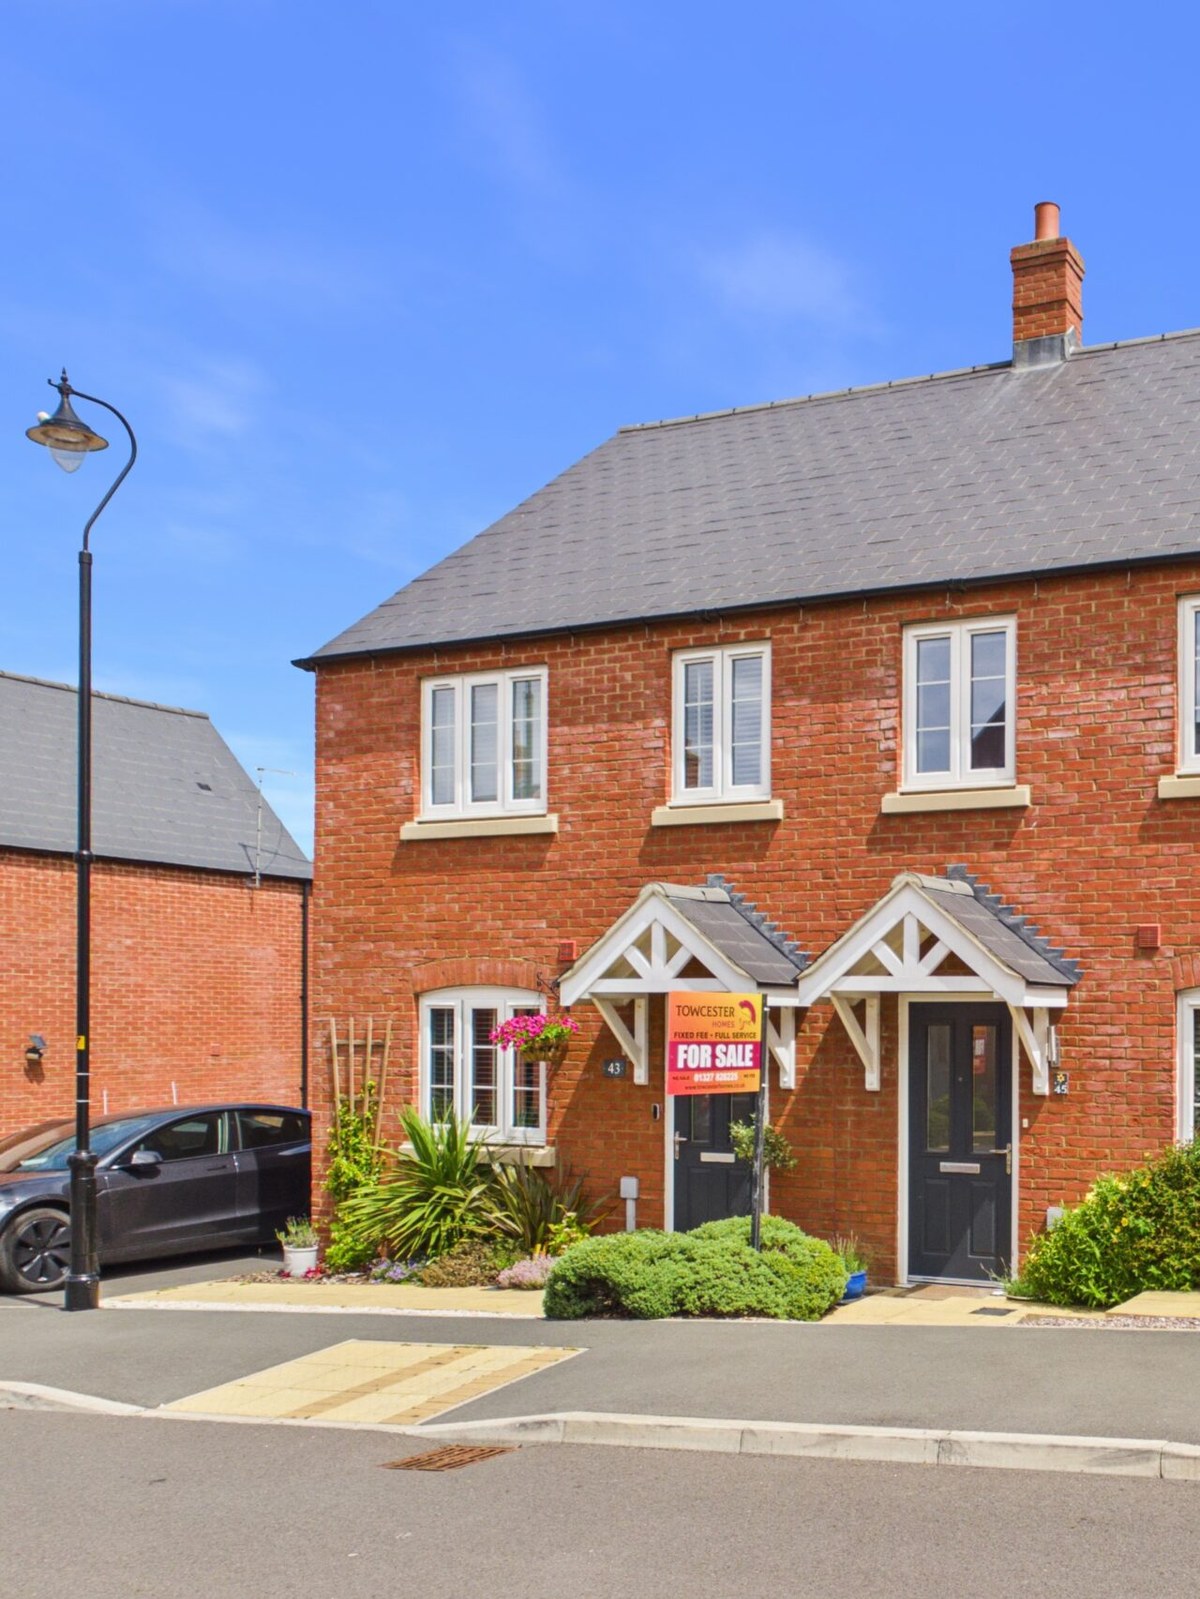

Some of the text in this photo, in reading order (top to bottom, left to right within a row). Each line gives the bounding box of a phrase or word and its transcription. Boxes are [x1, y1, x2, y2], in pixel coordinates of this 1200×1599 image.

[675, 1005, 735, 1018] TOWCESTER
[712, 1020, 735, 1028] HOMES
[673, 1031, 695, 1039] FIXED
[696, 1031, 709, 1039] FEE
[714, 1031, 730, 1039] FULL
[732, 1031, 756, 1039] SERVICE
[677, 1043, 754, 1069] FOR SALE
[608, 1062, 621, 1075] 43
[1054, 1084, 1067, 1094] 45
